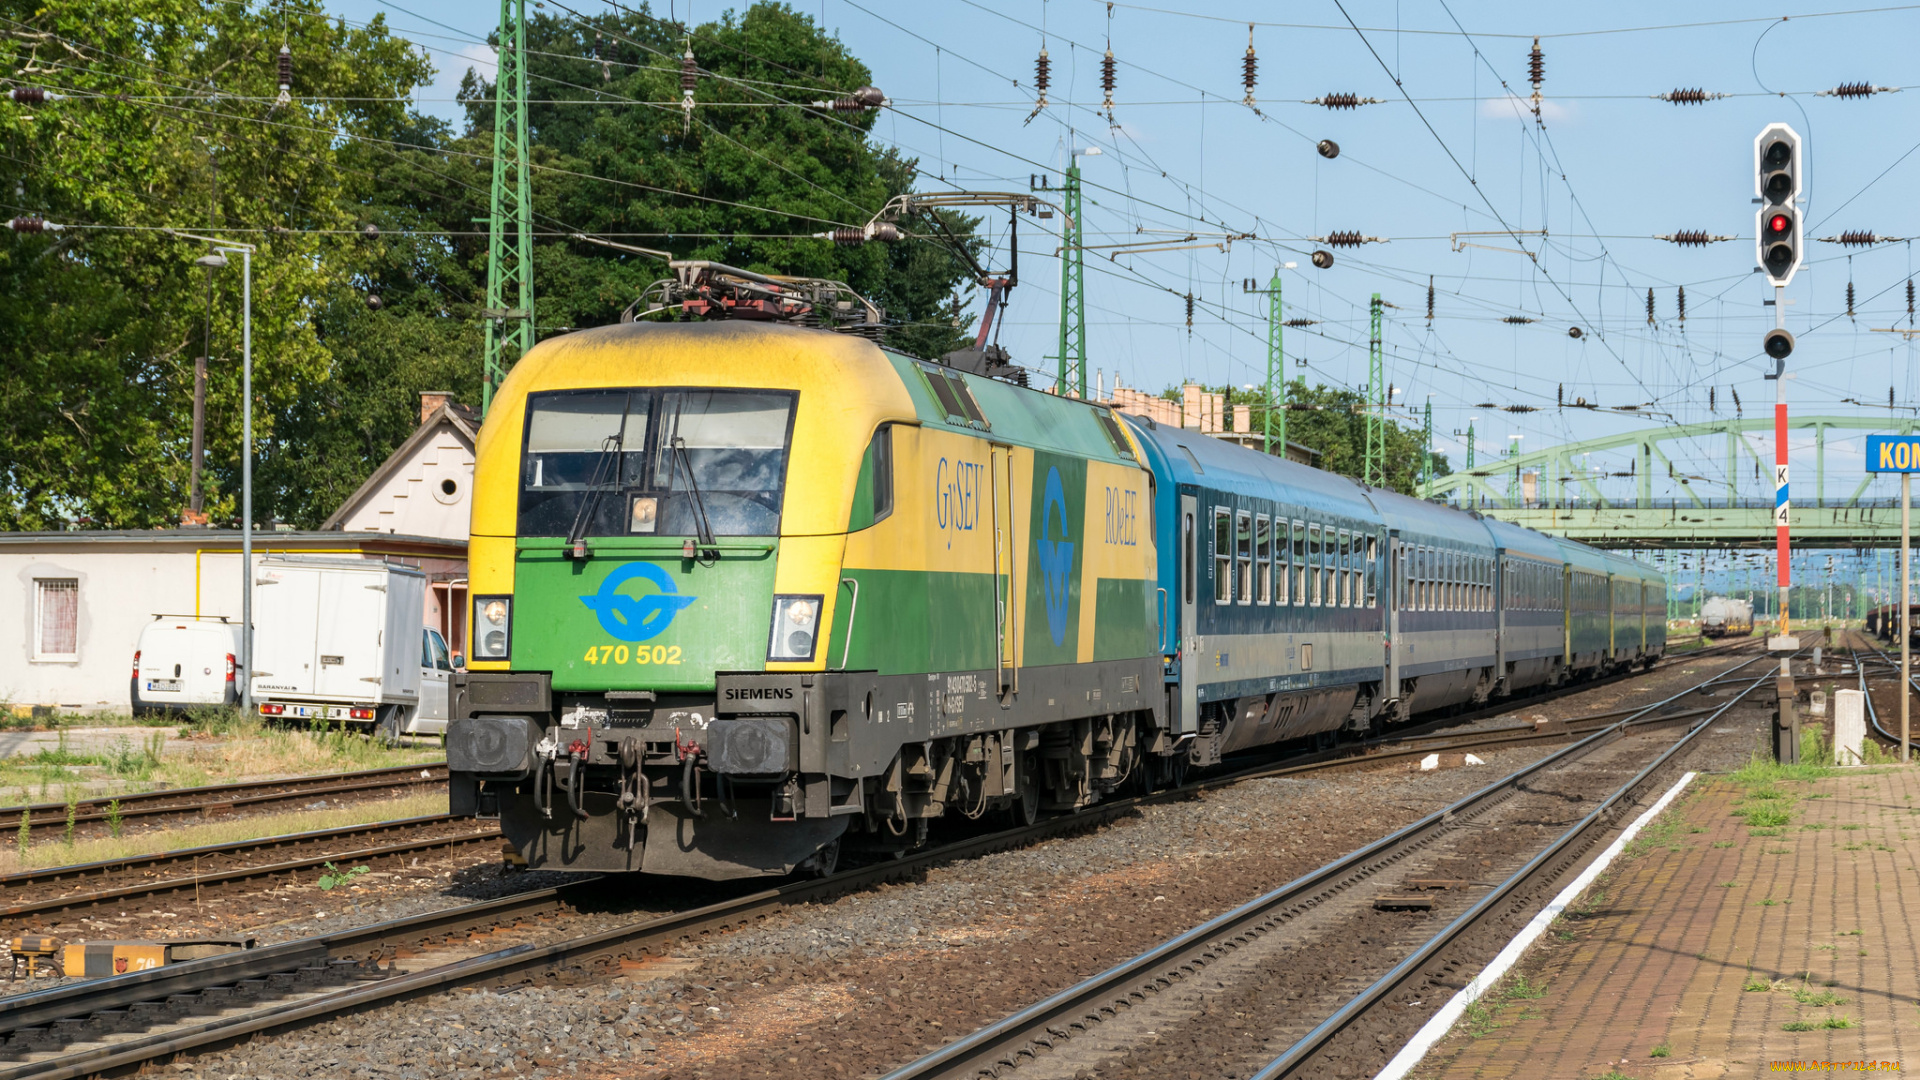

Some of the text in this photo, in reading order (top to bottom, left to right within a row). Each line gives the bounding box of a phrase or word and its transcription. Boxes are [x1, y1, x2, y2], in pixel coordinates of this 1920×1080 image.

[1778, 468, 1786, 483] K
[936, 457, 984, 550] GySEV
[1105, 486, 1137, 546] ROeEE
[1778, 508, 1787, 523] 4
[583, 645, 682, 665] 470 502
[725, 687, 794, 700] SIEMENS
